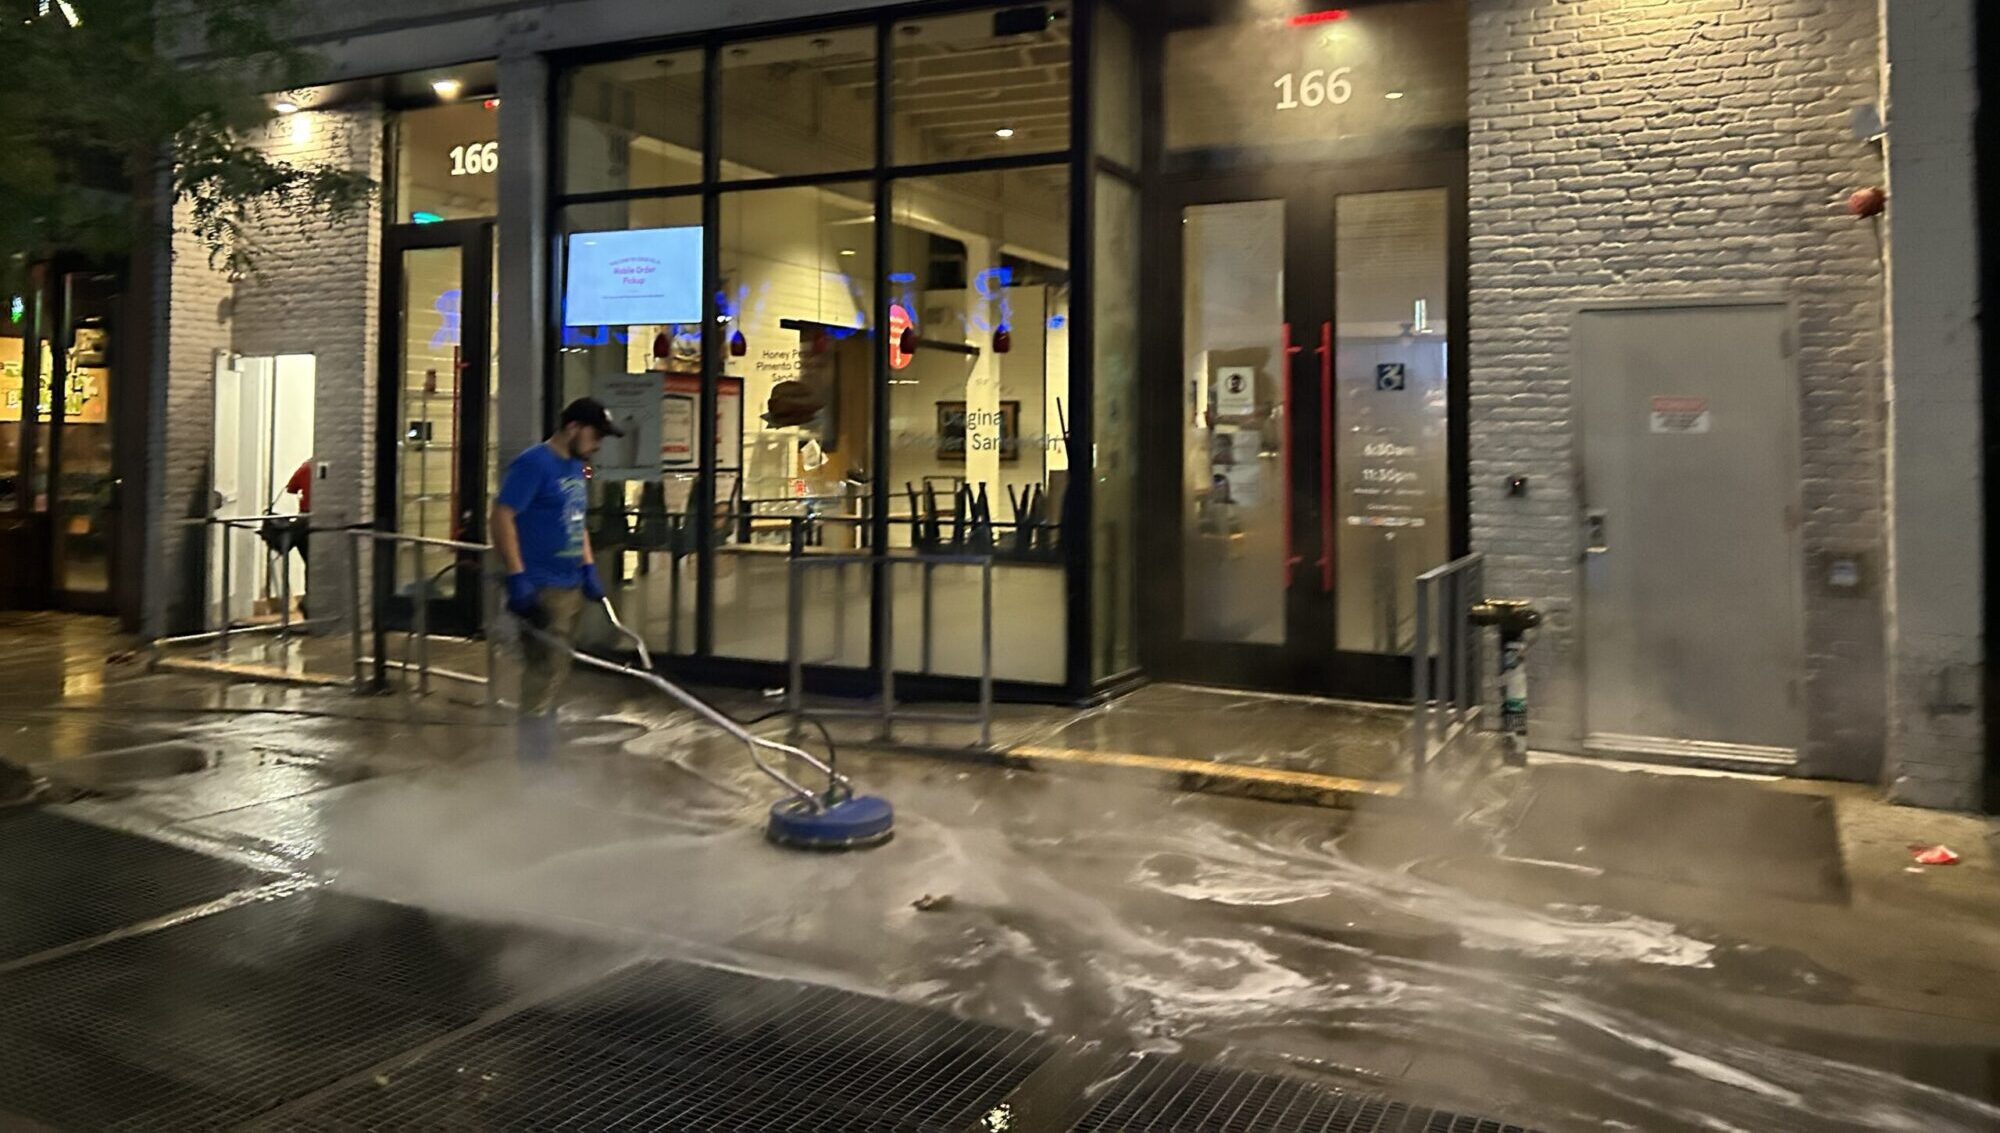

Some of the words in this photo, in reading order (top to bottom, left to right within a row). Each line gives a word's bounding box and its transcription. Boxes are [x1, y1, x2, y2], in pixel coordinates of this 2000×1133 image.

[1273, 66, 1352, 111] 166
[449, 140, 499, 176] 166
[763, 350, 789, 358] Honey
[757, 361, 792, 370] Pimento
